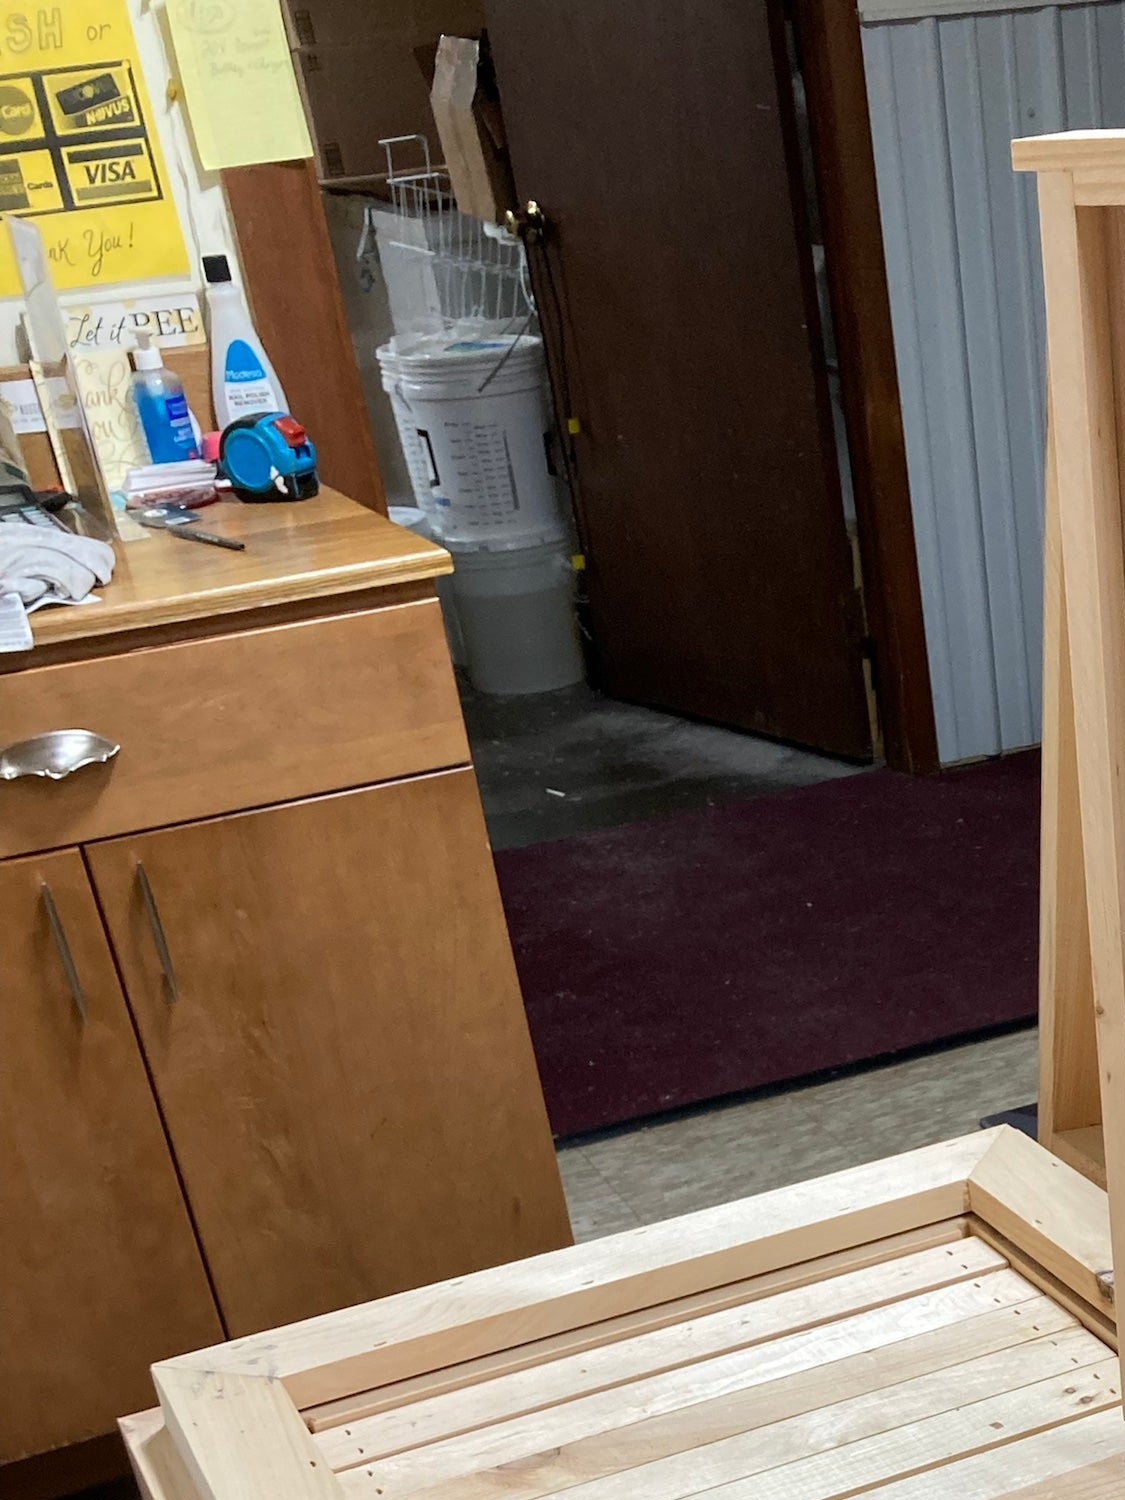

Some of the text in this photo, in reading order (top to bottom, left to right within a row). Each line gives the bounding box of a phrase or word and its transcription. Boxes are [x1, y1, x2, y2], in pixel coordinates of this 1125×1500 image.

[0, 7, 112, 55] SH or
[86, 98, 130, 126] NOVUS
[27, 180, 54, 191] Cards
[84, 159, 137, 185] VISA
[69, 313, 104, 348] Let
[109, 316, 126, 344] it
